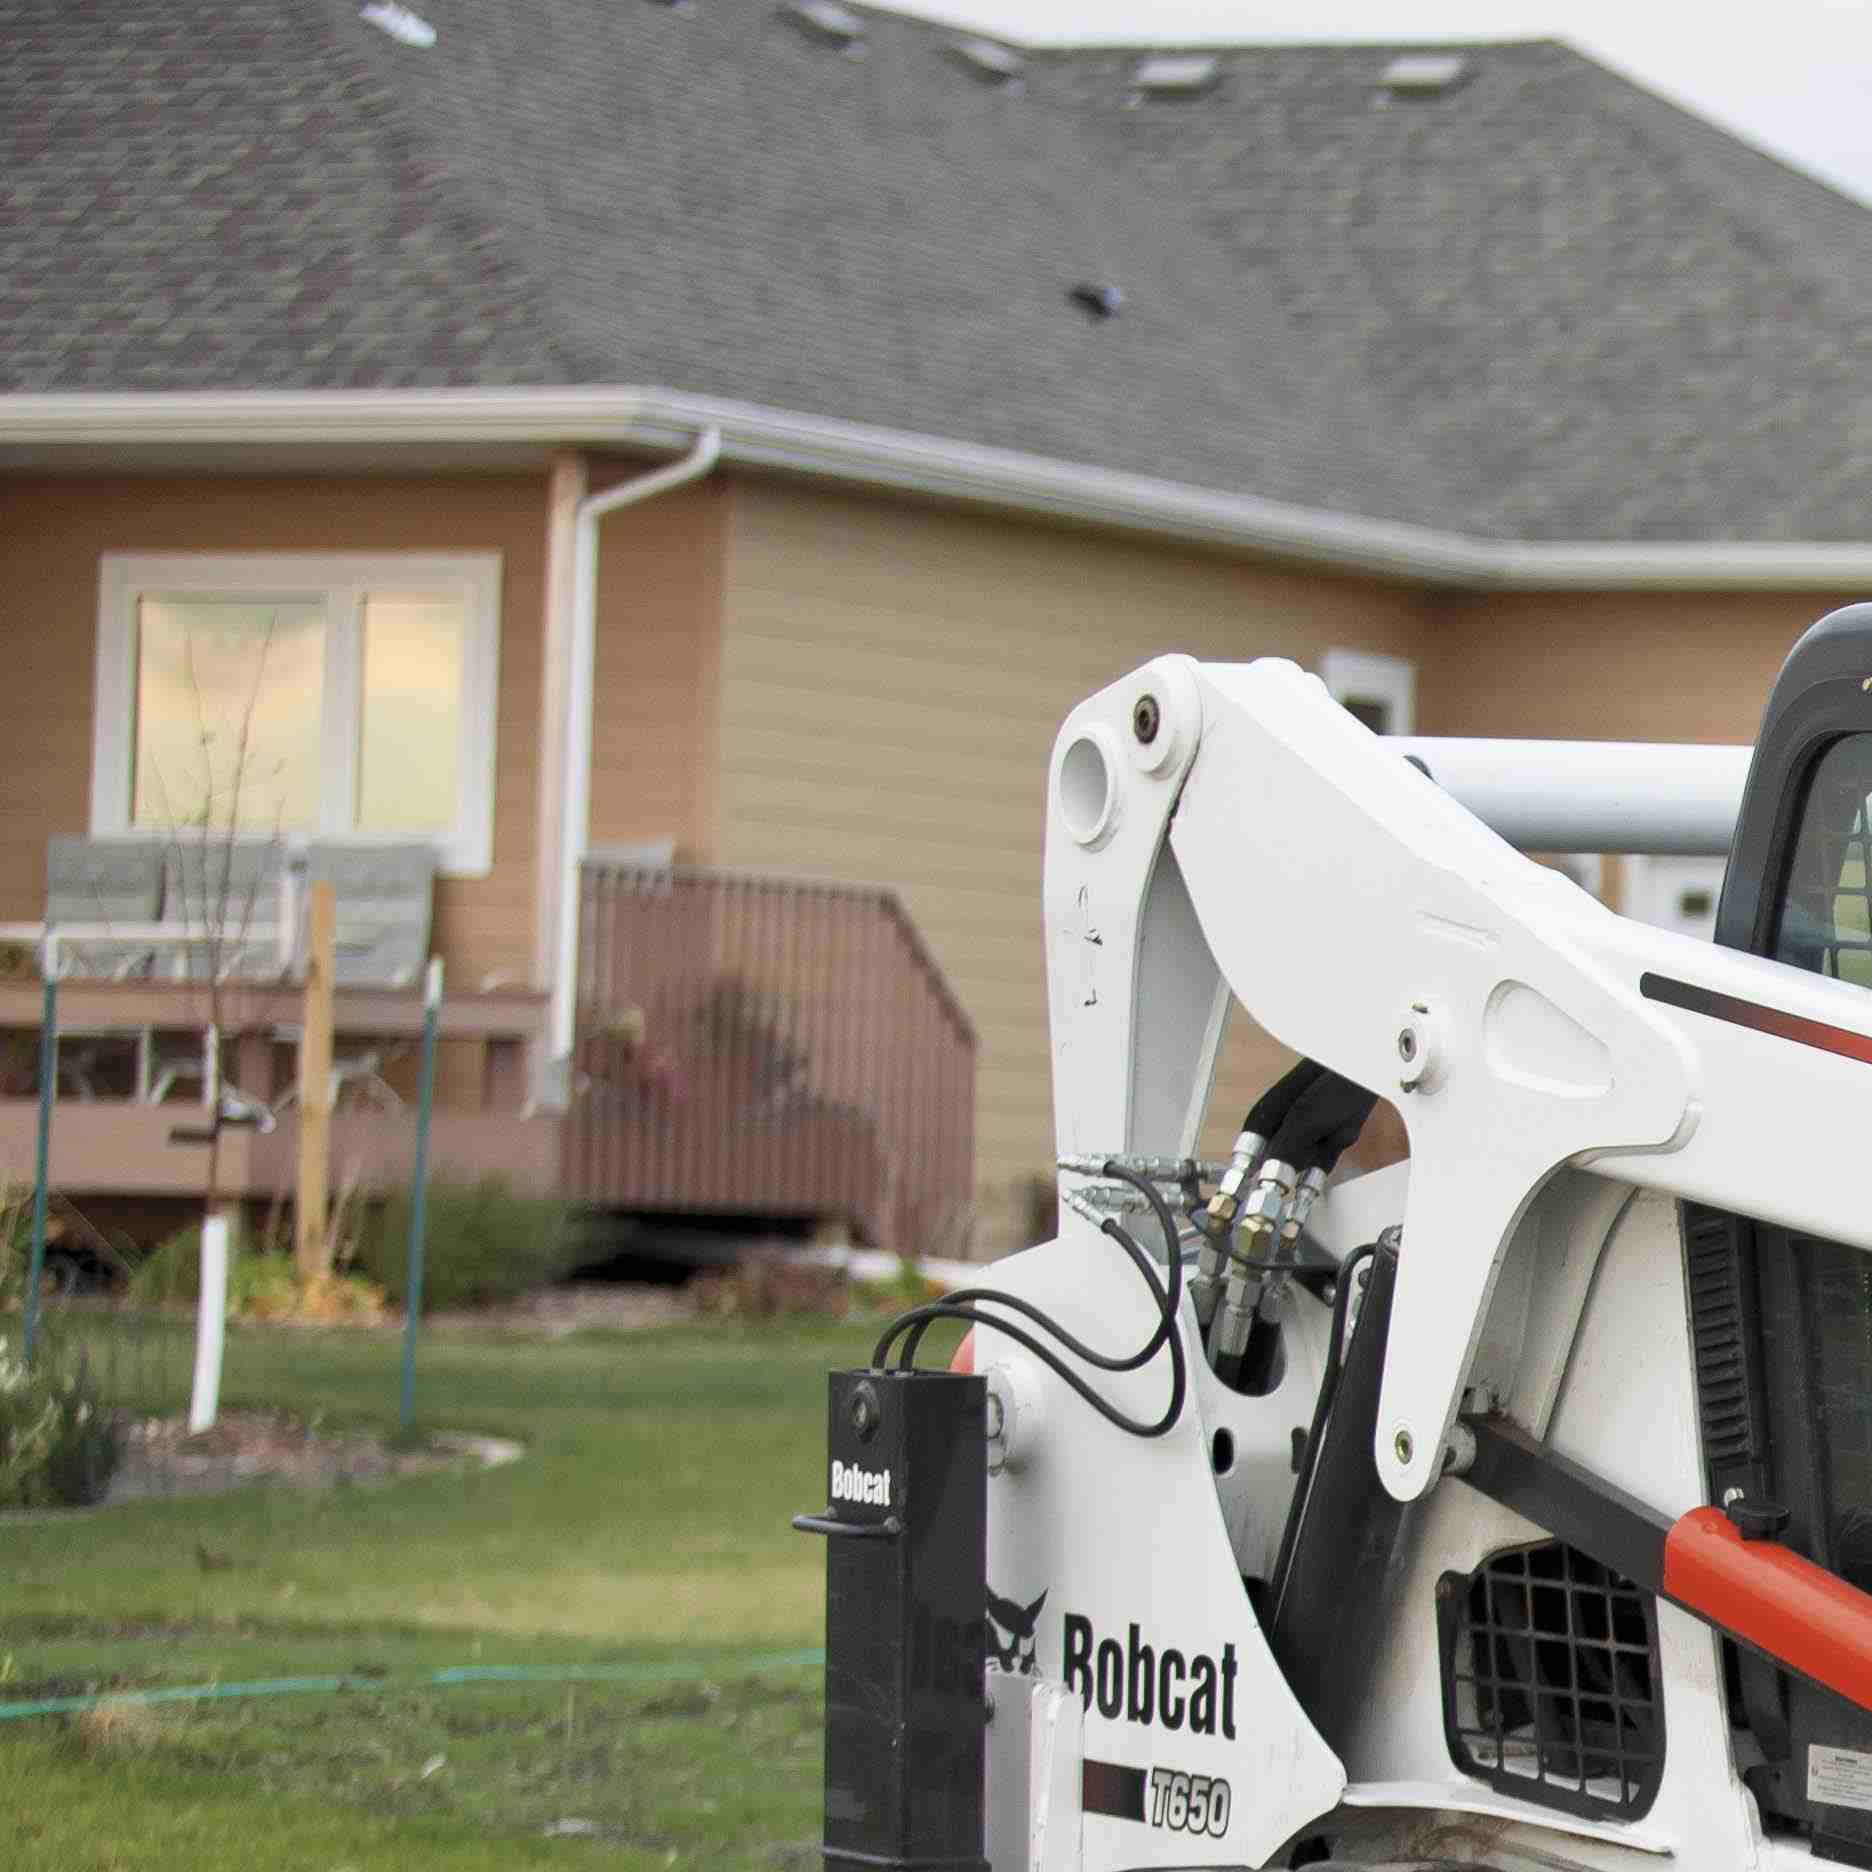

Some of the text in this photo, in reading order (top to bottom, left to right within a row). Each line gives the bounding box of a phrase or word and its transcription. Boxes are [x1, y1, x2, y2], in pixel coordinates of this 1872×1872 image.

[831, 1460, 891, 1507] Bobcat
[1063, 1612, 1238, 1741] Bobcat
[1150, 1766, 1231, 1839] T650
